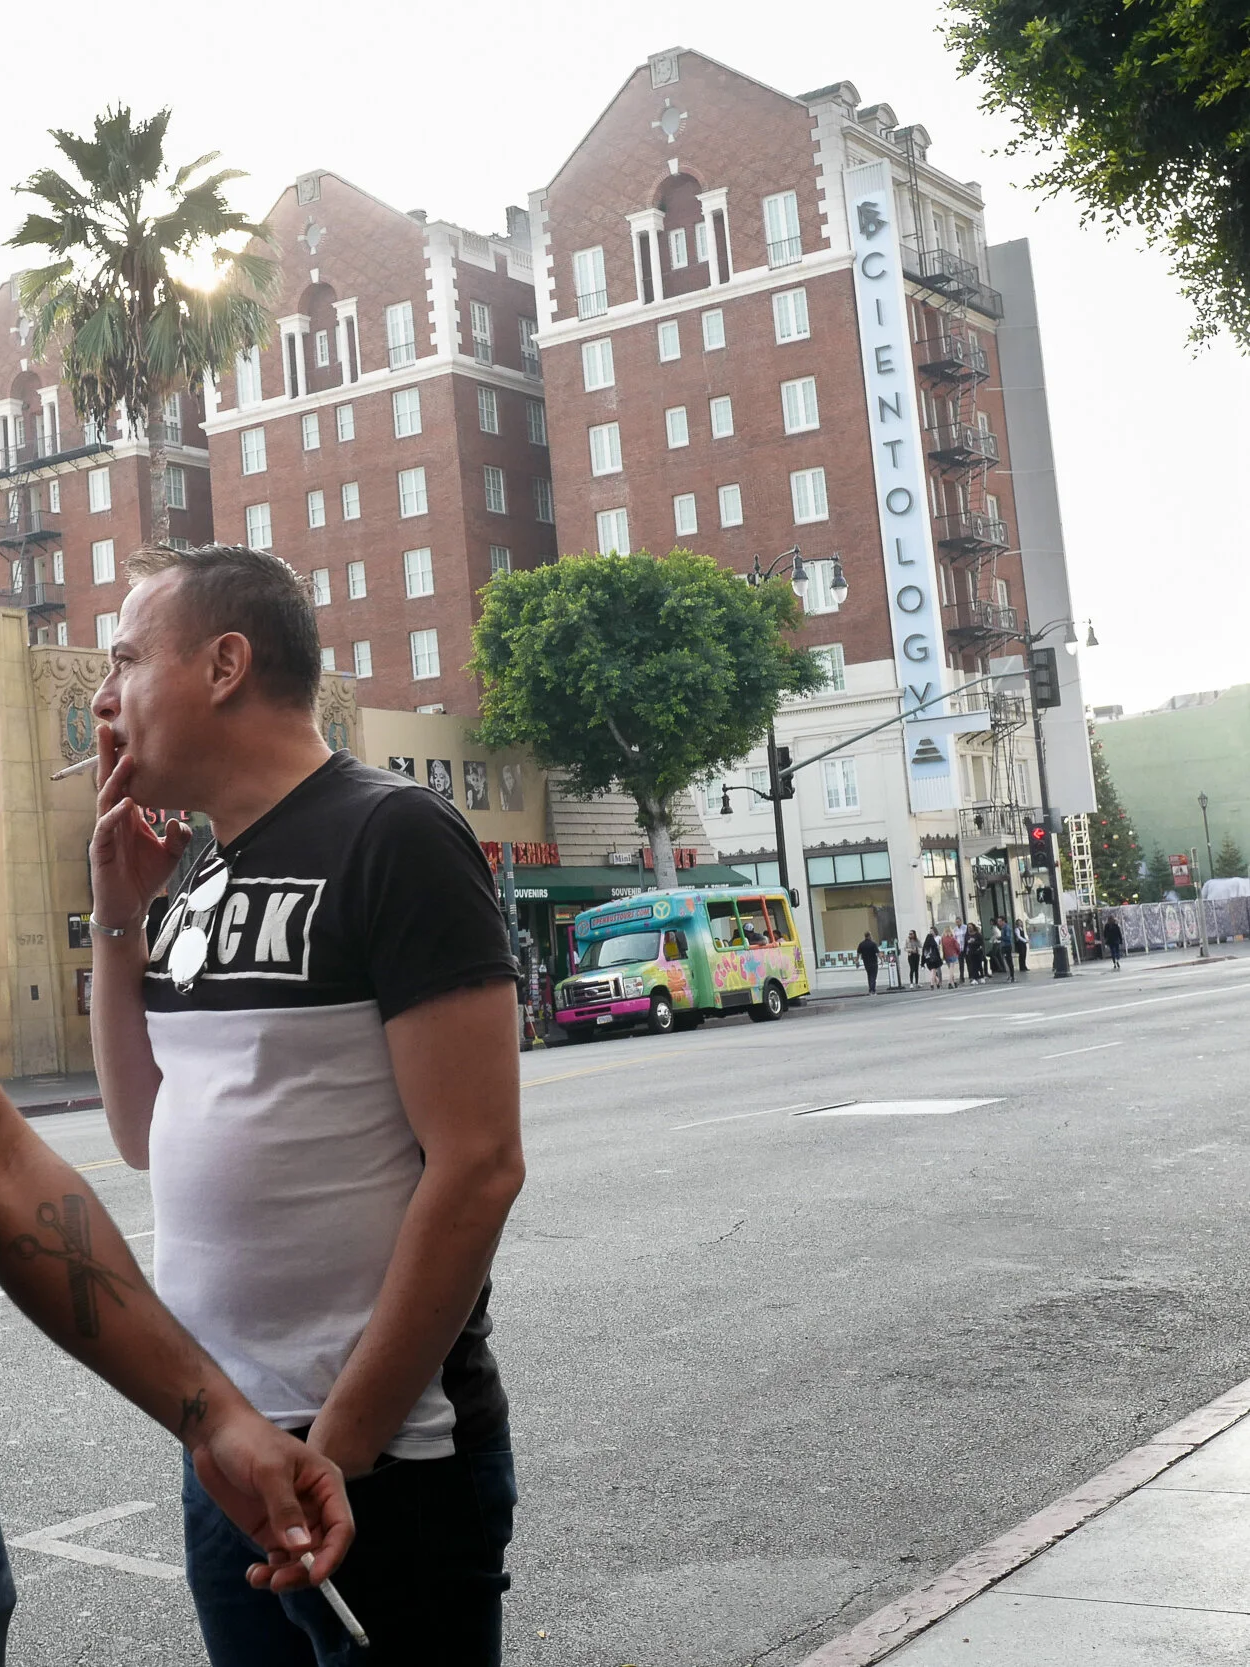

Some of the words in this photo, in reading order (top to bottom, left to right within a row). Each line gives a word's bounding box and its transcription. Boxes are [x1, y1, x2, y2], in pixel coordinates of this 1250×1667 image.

[614, 853, 631, 863] Mini
[643, 848, 697, 868] MKET
[514, 888, 549, 899] OUVENIRS
